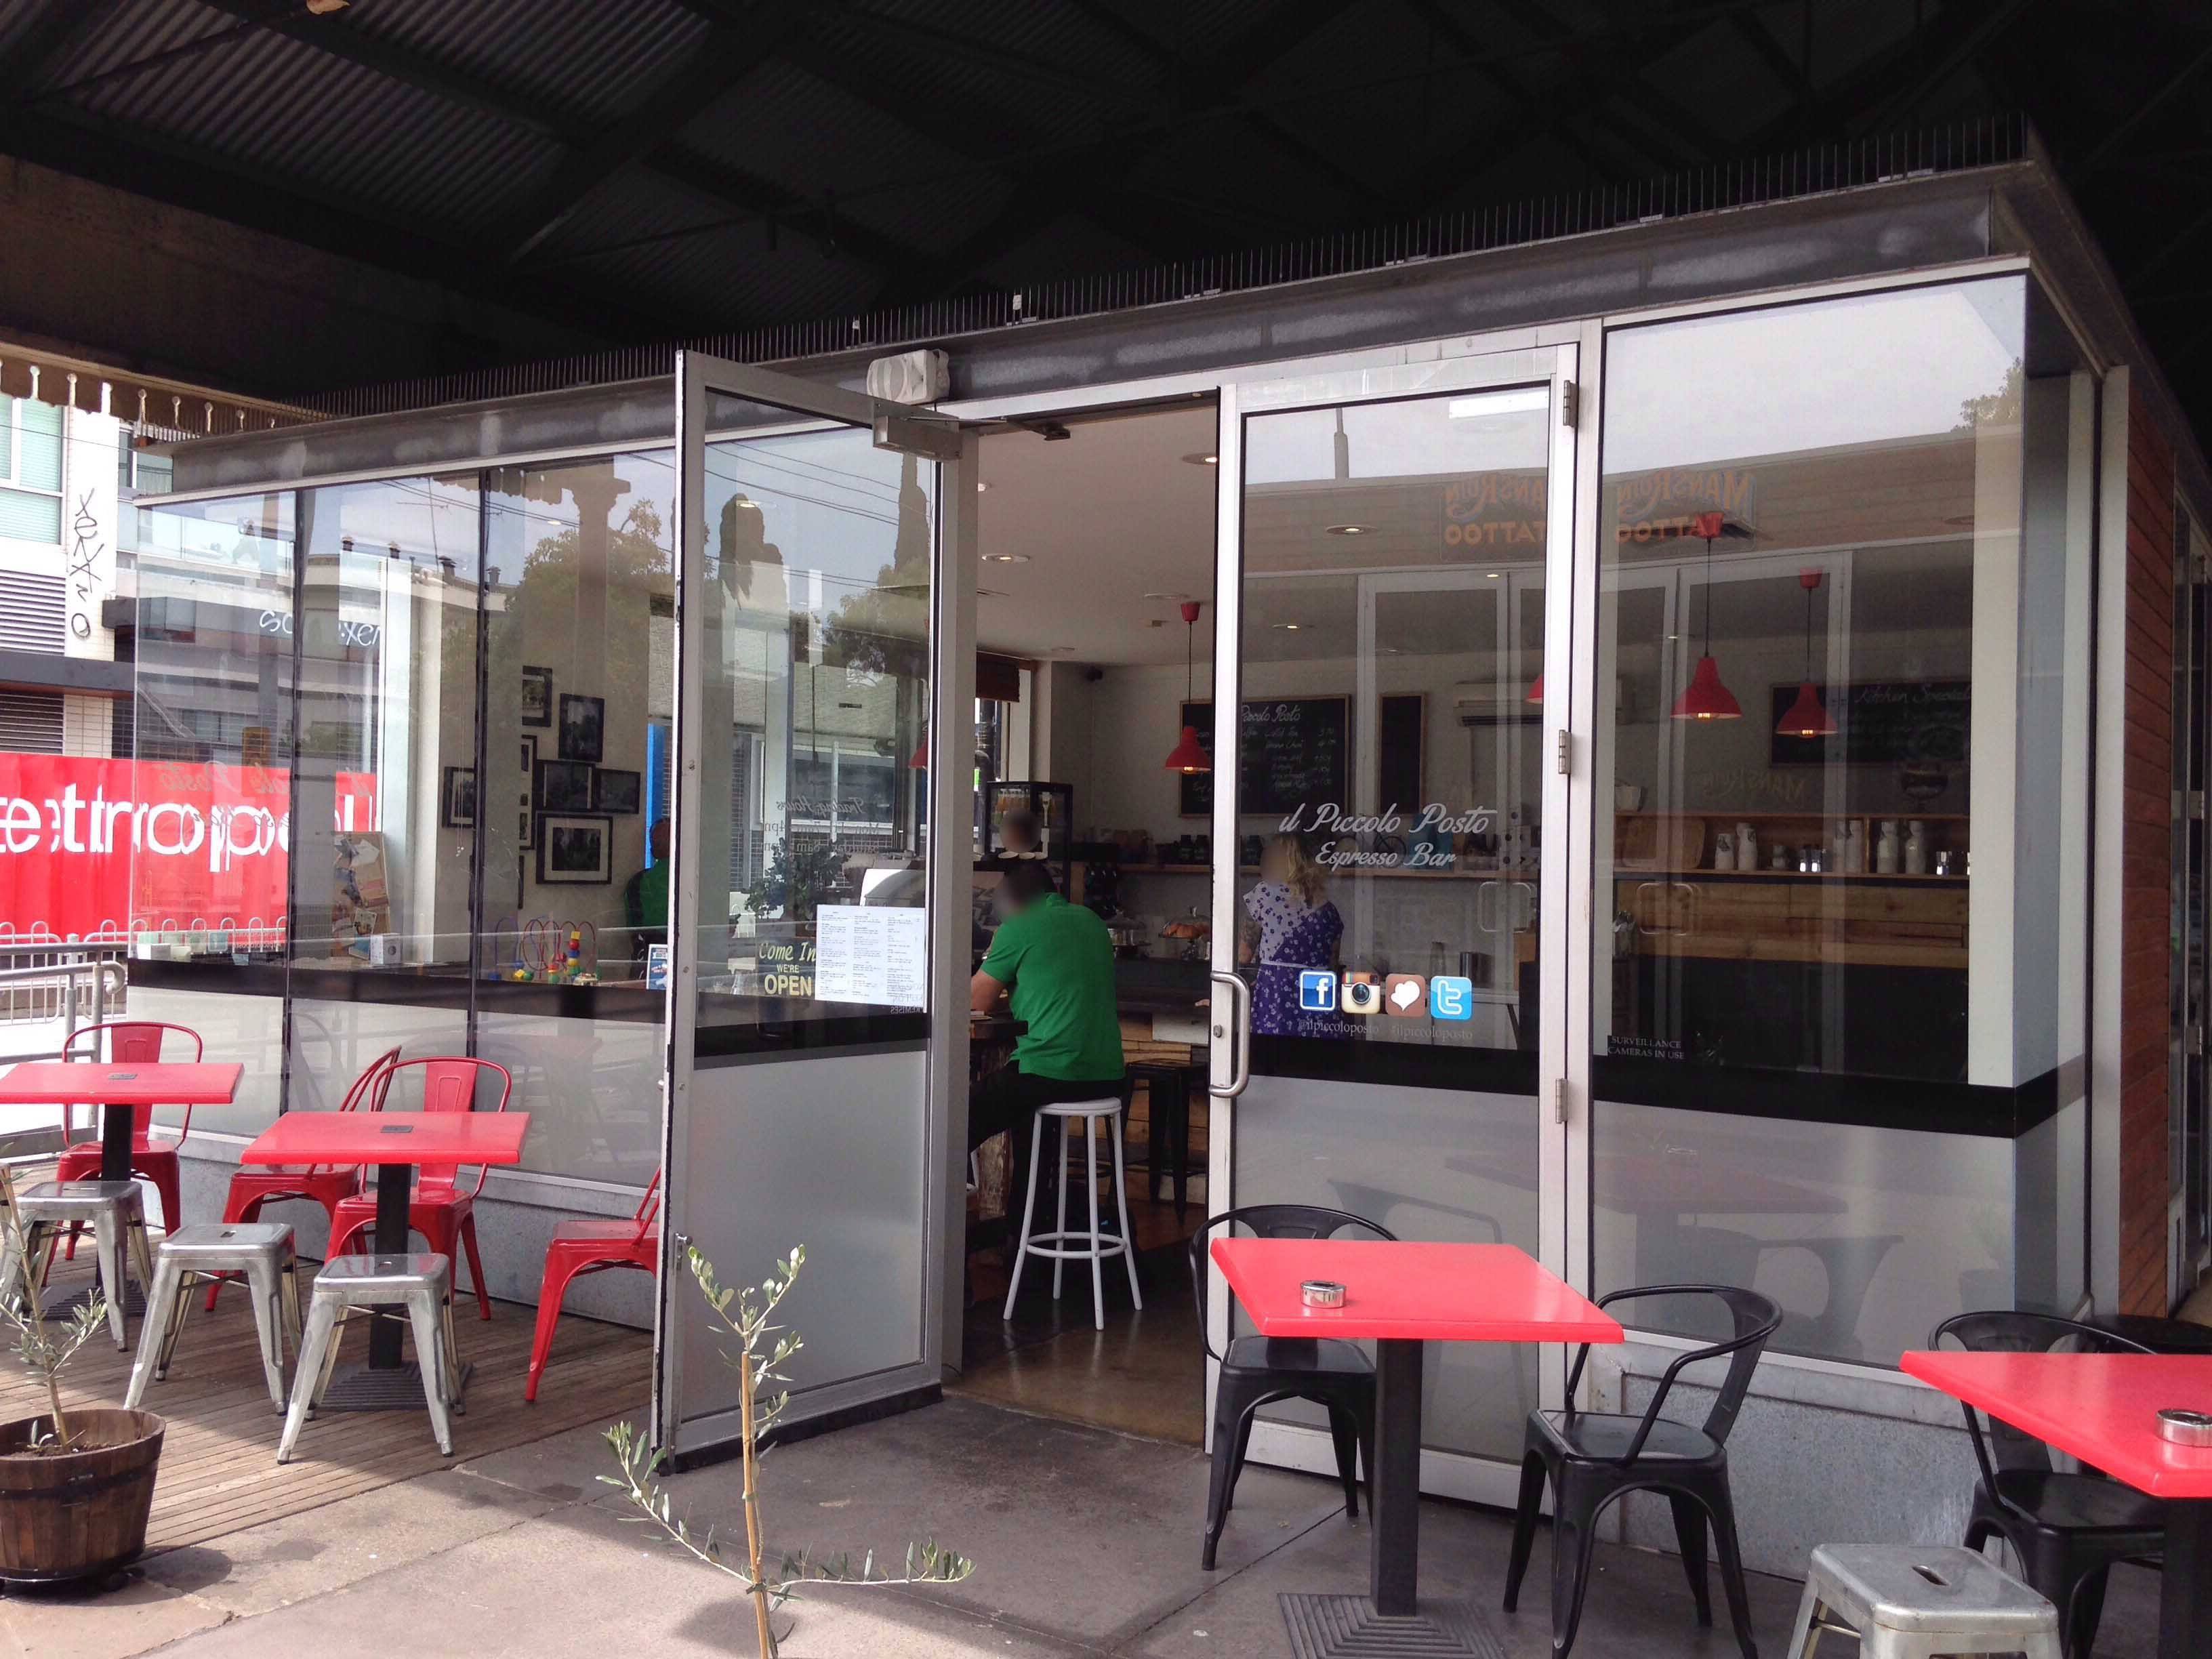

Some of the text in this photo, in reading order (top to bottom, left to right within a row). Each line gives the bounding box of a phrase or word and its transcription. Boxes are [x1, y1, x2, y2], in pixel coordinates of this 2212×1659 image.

[1303, 802, 1401, 833] Piccolo
[1409, 802, 1498, 834] Posto
[1315, 841, 1457, 872] Espresso Bar
[759, 942, 817, 962] Come In
[777, 964, 800, 973] WE'RE
[764, 975, 812, 997] OPEN
[1608, 1046, 1653, 1057] CAMERAS
[1611, 1036, 1681, 1048] SURVEILLANCE
